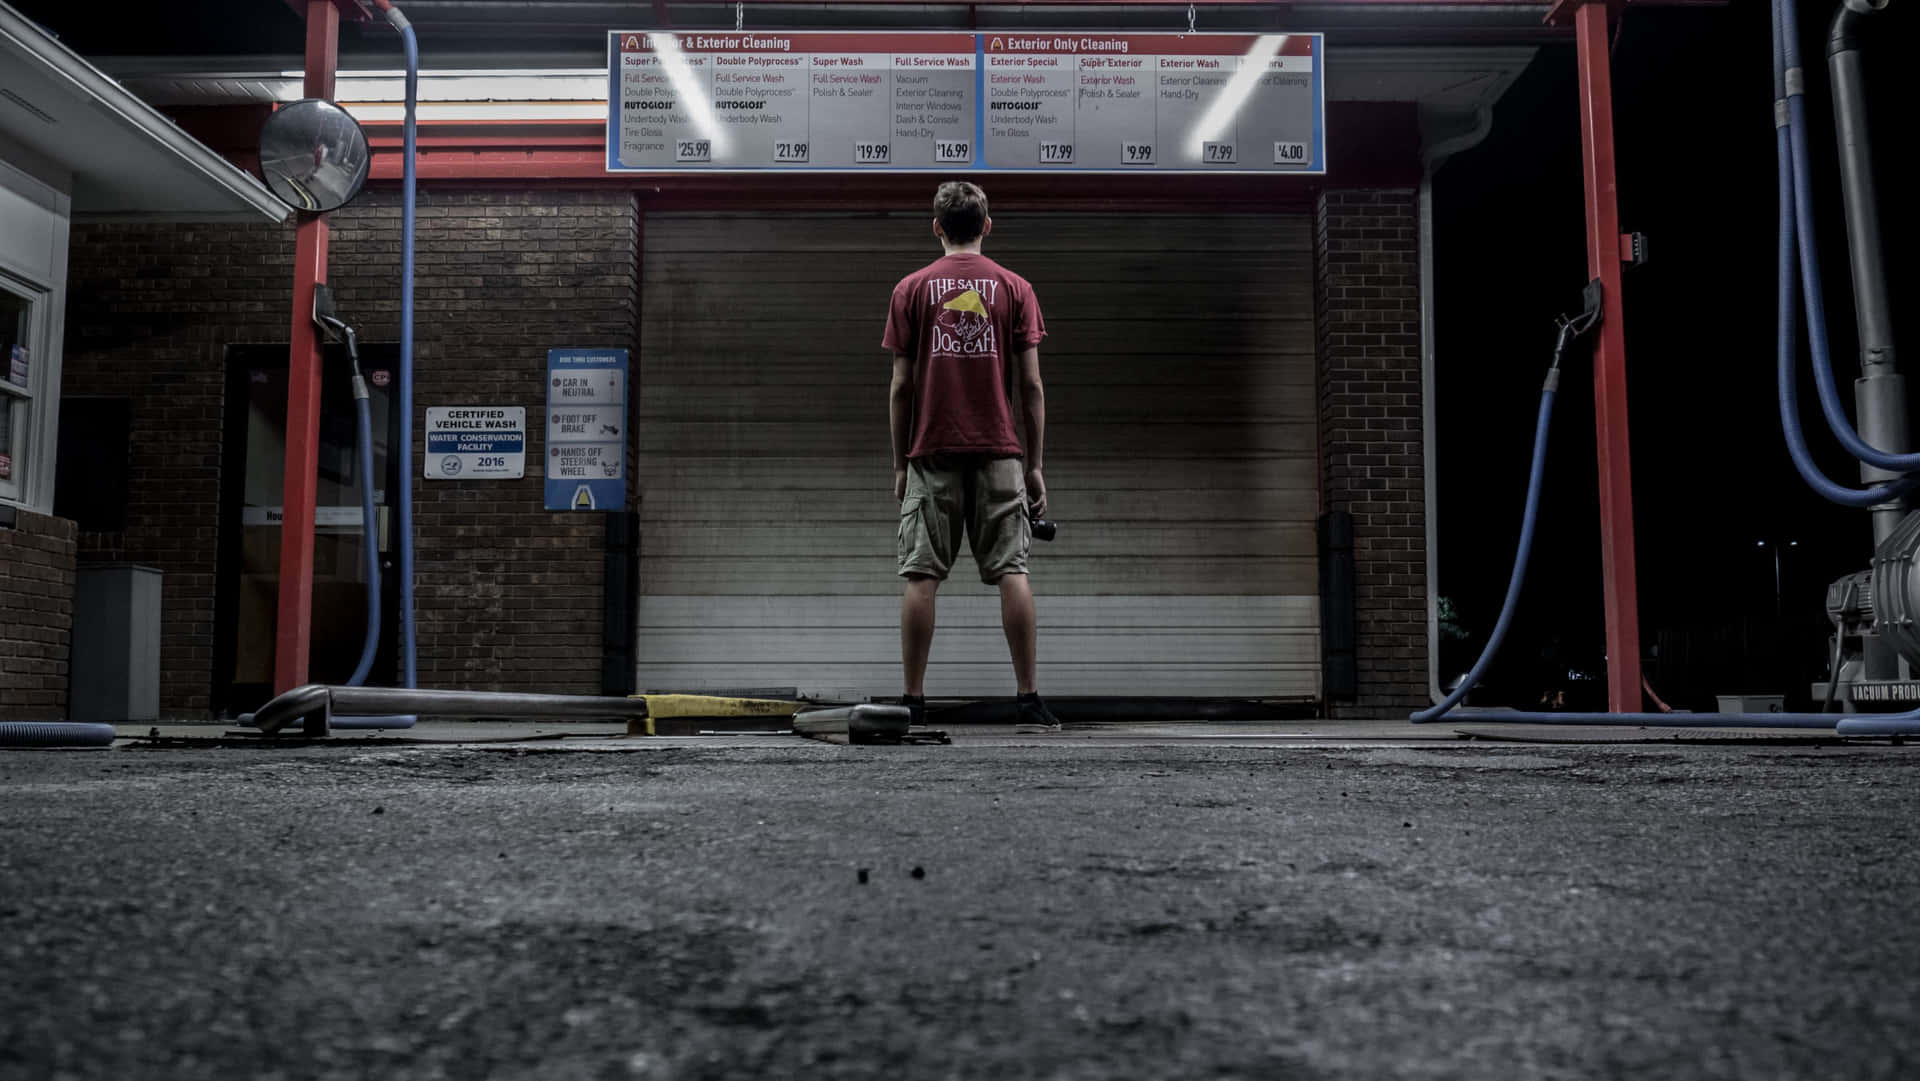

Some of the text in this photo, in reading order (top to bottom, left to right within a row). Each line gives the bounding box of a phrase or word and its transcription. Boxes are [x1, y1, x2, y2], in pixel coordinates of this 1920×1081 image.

[642, 37, 791, 51] Inor & Exterior Cleaning
[1008, 38, 1128, 52] Exterior Only Cleaning
[625, 57, 649, 66] Super
[717, 57, 746, 65] Double
[813, 57, 863, 67] Super Wash
[895, 57, 970, 66] Full Service Wash
[991, 57, 1058, 68] Exterior Special
[1081, 59, 1142, 69] Super Exterior
[1160, 59, 1220, 68] Exterior Wash
[625, 74, 665, 83] Full Servic
[716, 74, 784, 83] Full Service Wash
[813, 74, 882, 83] Full Service Wash
[896, 75, 928, 84] Vacuum
[991, 74, 1045, 83] Exterior Wash
[1113, 76, 1135, 85] Wash
[1160, 76, 1192, 85] Exterior
[625, 88, 653, 97] Double
[716, 88, 743, 96] Double
[813, 88, 873, 97] Polish & Sealer
[896, 88, 964, 99] Exterior Cleaning
[991, 88, 1018, 97] Double
[1081, 89, 1140, 98] Polish & Sealer
[1161, 89, 1199, 100] Hand-Dry
[896, 102, 962, 111] Interior Windows
[625, 115, 667, 125] Underbody
[719, 114, 782, 124] nderbody Wash
[896, 115, 959, 124] Dash & Console
[991, 115, 1057, 125] Underbody Wash
[625, 128, 663, 136] Tire Gloss
[896, 128, 935, 138] Hand-Dry
[991, 128, 1030, 137] Tire Gloss
[624, 142, 665, 151] Fragrance
[928, 279, 998, 305] THE SALTY
[932, 325, 961, 353] DOG
[562, 378, 588, 387] CAR IN
[562, 388, 595, 397] NEUTRAL
[448, 410, 504, 419] CERTIFIED
[562, 414, 597, 423] FOOT OFF
[435, 421, 517, 429] VEHICLE WASH
[561, 424, 585, 433] BRAKE
[457, 443, 493, 451] FACILITY
[561, 448, 603, 456] HANDS OFF
[478, 457, 505, 467] 2016
[560, 457, 597, 466] STEERING
[560, 467, 586, 476] WHEEL
[266, 511, 283, 521] Hou
[1852, 685, 1889, 700] VACUUM
